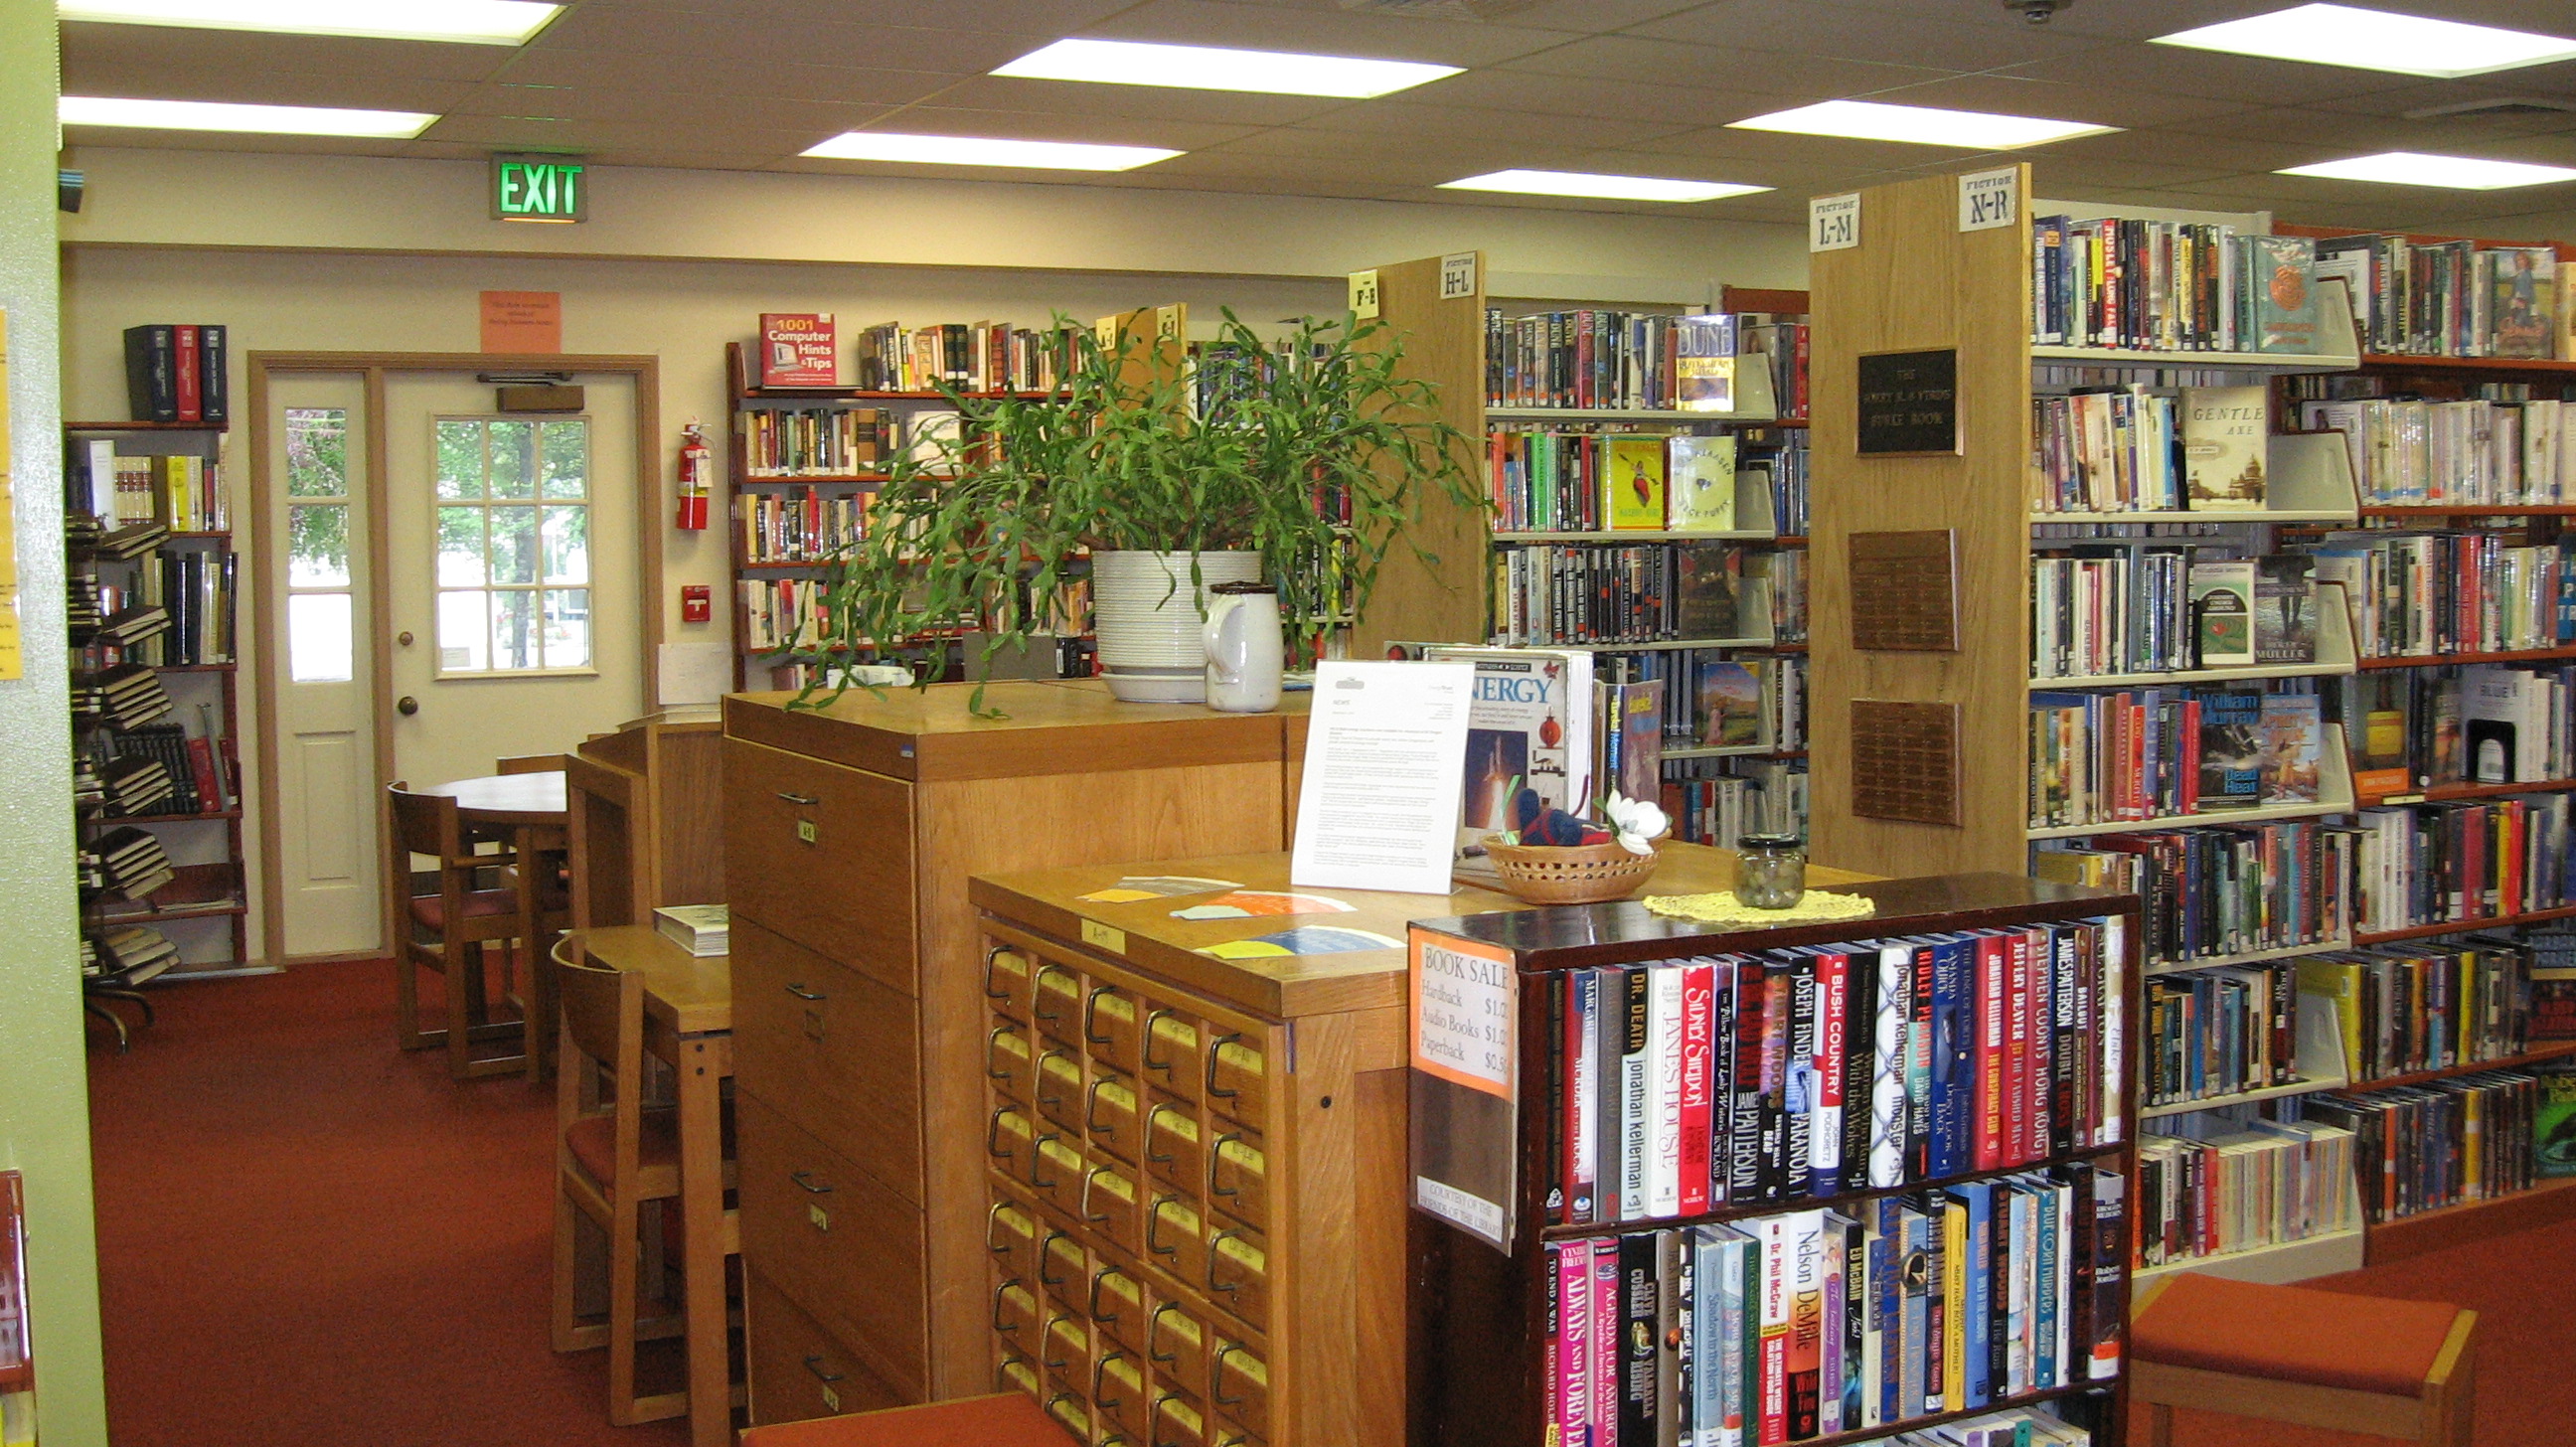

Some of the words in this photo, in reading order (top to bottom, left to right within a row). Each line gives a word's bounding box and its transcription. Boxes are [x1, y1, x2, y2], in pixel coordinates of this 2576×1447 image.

[501, 163, 583, 214] EXIT
[1967, 176, 2012, 190] FICTION
[1816, 201, 1855, 214] FICTION
[1971, 190, 2008, 225] N-R
[1819, 214, 1852, 245] L-M
[1445, 270, 1468, 295] H-L
[768, 330, 832, 344] Computer
[777, 319, 814, 332] 1001
[1678, 325, 1733, 357] DUNE
[799, 344, 832, 355] Hints
[806, 358, 833, 371] Tips
[2194, 407, 2264, 420] GENTLE
[2226, 425, 2254, 435] AXE
[1472, 677, 1552, 704] NERGY
[2200, 696, 2258, 709] William
[2202, 711, 2258, 724] Murray
[1425, 947, 1465, 980] BOOK
[1470, 959, 1508, 991] SALE
[2012, 942, 2025, 990] JEFFERY
[2035, 944, 2048, 1003] STEPHEN
[2057, 937, 2073, 970] JAMES
[1421, 979, 1462, 1007] Hardback
[1631, 973, 1646, 1000] DR.
[1791, 973, 1814, 1018] JOSEPH
[1917, 951, 1931, 999] RIDLEY
[1936, 958, 1949, 995] QUICK
[1948, 954, 1957, 1000] AMANDA
[1989, 954, 2002, 999] JONATHAN
[1686, 988, 1709, 1043] SIDNEY
[1770, 975, 1785, 1042] STUART
[1830, 975, 1843, 1017] BUSH
[2012, 993, 2024, 1040] DEAVER
[2056, 970, 2073, 1027] PATTERSON
[2077, 986, 2087, 1030] BAILOUT
[1421, 1005, 1447, 1029] Audio
[1448, 1014, 1480, 1039] Books
[1630, 1005, 1646, 1048] DEATH
[1916, 1006, 1931, 1068] PEARSON
[1988, 1000, 2001, 1047] KELLERMAN
[2035, 1009, 2048, 1060] COONTS
[1421, 1031, 1465, 1061] Paperback
[1793, 1024, 1811, 1068] FINDER
[1827, 1022, 1842, 1096] COUNTRY
[1894, 1023, 1909, 1084] kellerman
[2013, 1056, 2022, 1073] THE
[2057, 1035, 2072, 1081] DOUBLE
[1626, 1059, 1646, 1119] jonathan
[1685, 1044, 1708, 1107] SHELDON
[1768, 1045, 1784, 1108] WOODS
[1850, 1052, 1863, 1086] With
[1862, 1052, 1873, 1104] Women
[2034, 1067, 2047, 1107] HONG
[1848, 1089, 1861, 1110] the
[1913, 1077, 1924, 1103] DAVID
[1987, 1068, 1998, 1114] CONSPIRACY
[2012, 1077, 2022, 1122] VANISHED
[1659, 1091, 1679, 1170] HOUSE
[1822, 1112, 1833, 1162] PODHORETZ
[1846, 1112, 1860, 1159] Wolves
[1860, 1105, 1871, 1139] Who
[1890, 1095, 1905, 1149] monster
[1913, 1107, 1924, 1135] HAYES
[1987, 1116, 1998, 1135] CLUB
[2011, 1124, 2021, 1145] MAN
[2034, 1111, 2046, 1148] KONG
[1627, 1123, 1646, 1190] kellerman
[1733, 1109, 1759, 1189] PATTERSON
[1762, 1130, 1773, 1154] DEAD
[1788, 1112, 1809, 1185] PARANOIA
[1858, 1142, 1868, 1172] Run
[1997, 1192, 2009, 1248] STUART
[2042, 1206, 2055, 1231] BLUE
[1548, 1259, 1556, 1272] TO
[1770, 1243, 1782, 1256] Dr.
[1770, 1257, 1781, 1276] Phil
[1797, 1230, 1820, 1285] Nelson
[1850, 1246, 1862, 1262] ED
[2042, 1232, 2055, 1265] CORN
[1630, 1269, 1644, 1319] CUSSLER
[1644, 1282, 1655, 1317] CLIVE
[1770, 1279, 1782, 1319] McGraw
[1849, 1263, 1861, 1301] McBAIN
[1996, 1253, 2008, 1311] WOODS
[2041, 1267, 2054, 1314] MURDERS
[1566, 1274, 1586, 1341] ALWAYS
[1605, 1287, 1617, 1346] AGENDA
[1707, 1294, 1719, 1340] Shadow
[1796, 1288, 1818, 1351] DeMille
[1572, 1344, 1582, 1370] AND
[1605, 1351, 1617, 1377] FOR
[1630, 1362, 1643, 1400] RISING
[1643, 1359, 1654, 1418] VALHALLA
[1706, 1370, 1718, 1399] North
[1605, 1382, 1616, 1446] AMERICA
